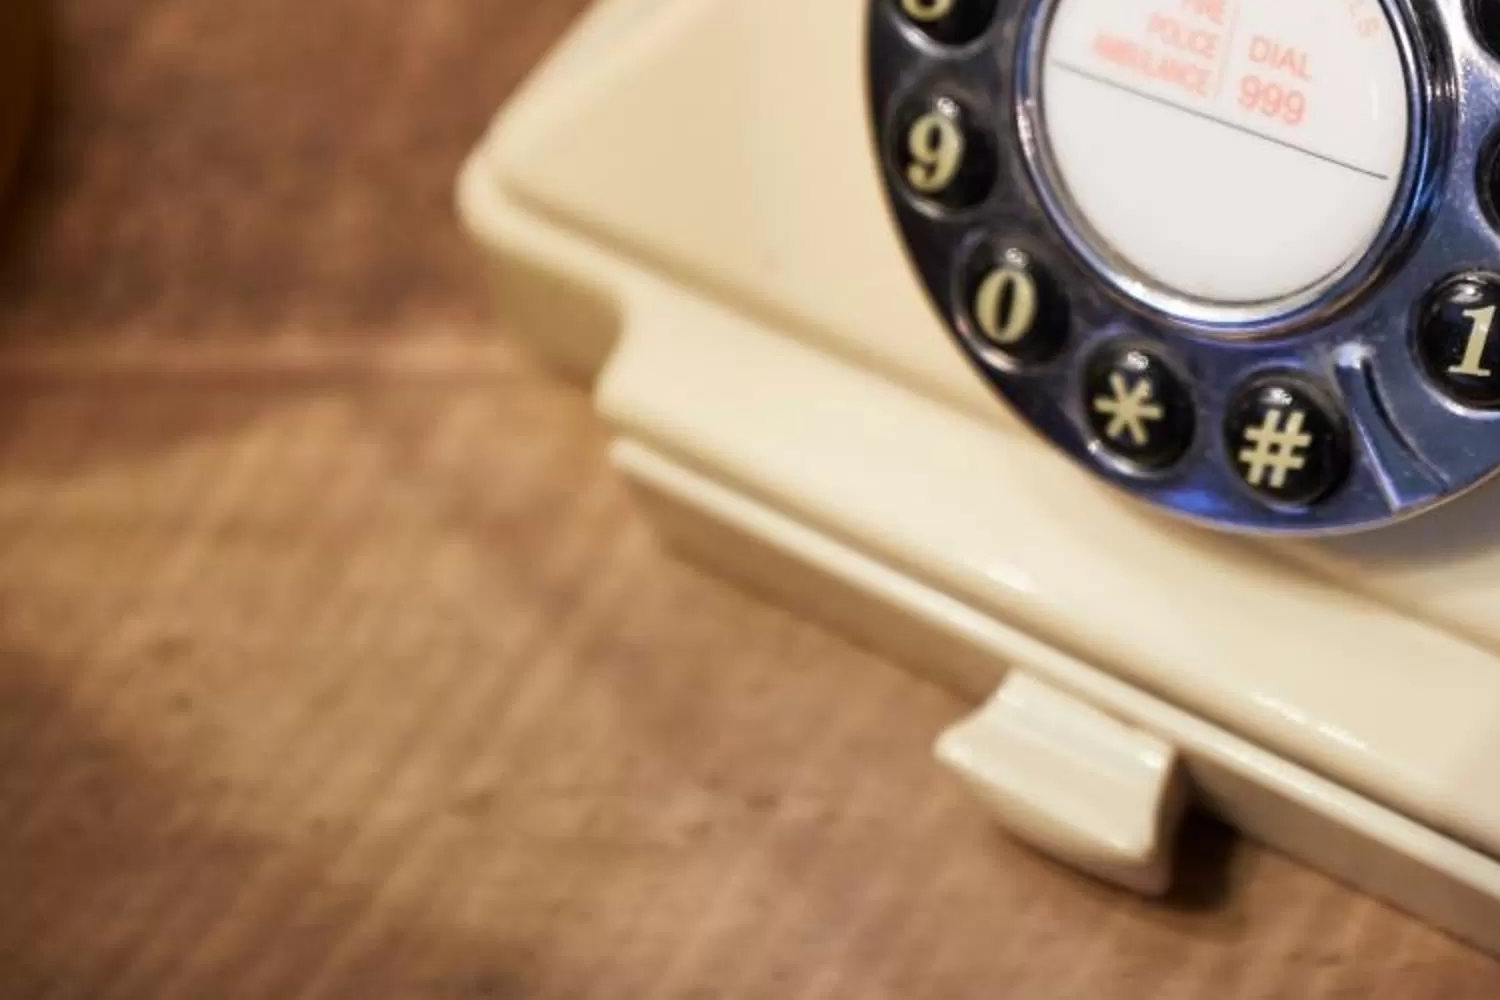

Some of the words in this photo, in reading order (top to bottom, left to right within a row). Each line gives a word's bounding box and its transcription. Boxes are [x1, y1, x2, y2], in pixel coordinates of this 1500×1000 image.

[1248, 34, 1312, 82] DIAL
[1237, 74, 1306, 125] 999
[907, 110, 962, 190] 9
[977, 265, 1035, 344] 0
[1447, 305, 1497, 377] 1
